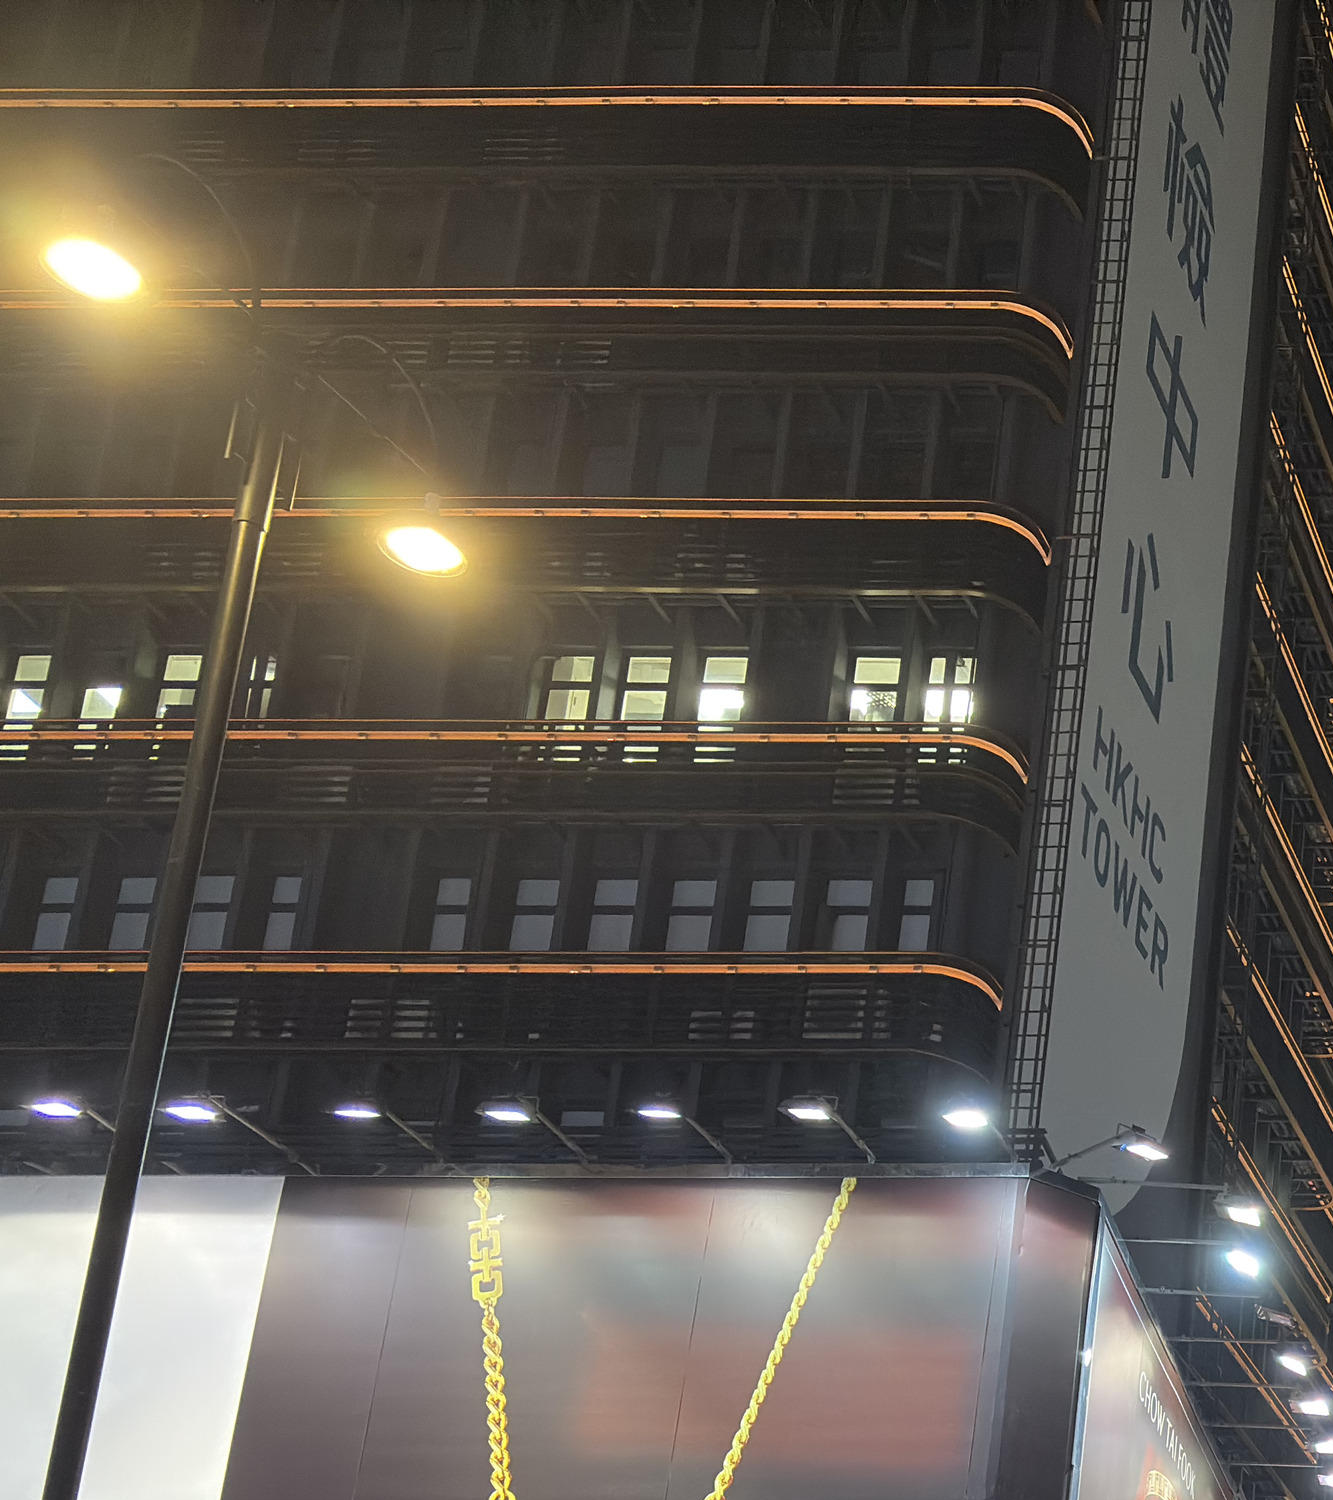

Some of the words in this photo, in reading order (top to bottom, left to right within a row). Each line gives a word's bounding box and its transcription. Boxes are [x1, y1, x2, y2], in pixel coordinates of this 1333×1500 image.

[1093, 705, 1166, 884] HKHC
[1081, 782, 1169, 992] TOWER
[1139, 1371, 1166, 1436] CHOW
[1166, 1417, 1178, 1462] TAI
[1177, 1443, 1196, 1500] FOOK
